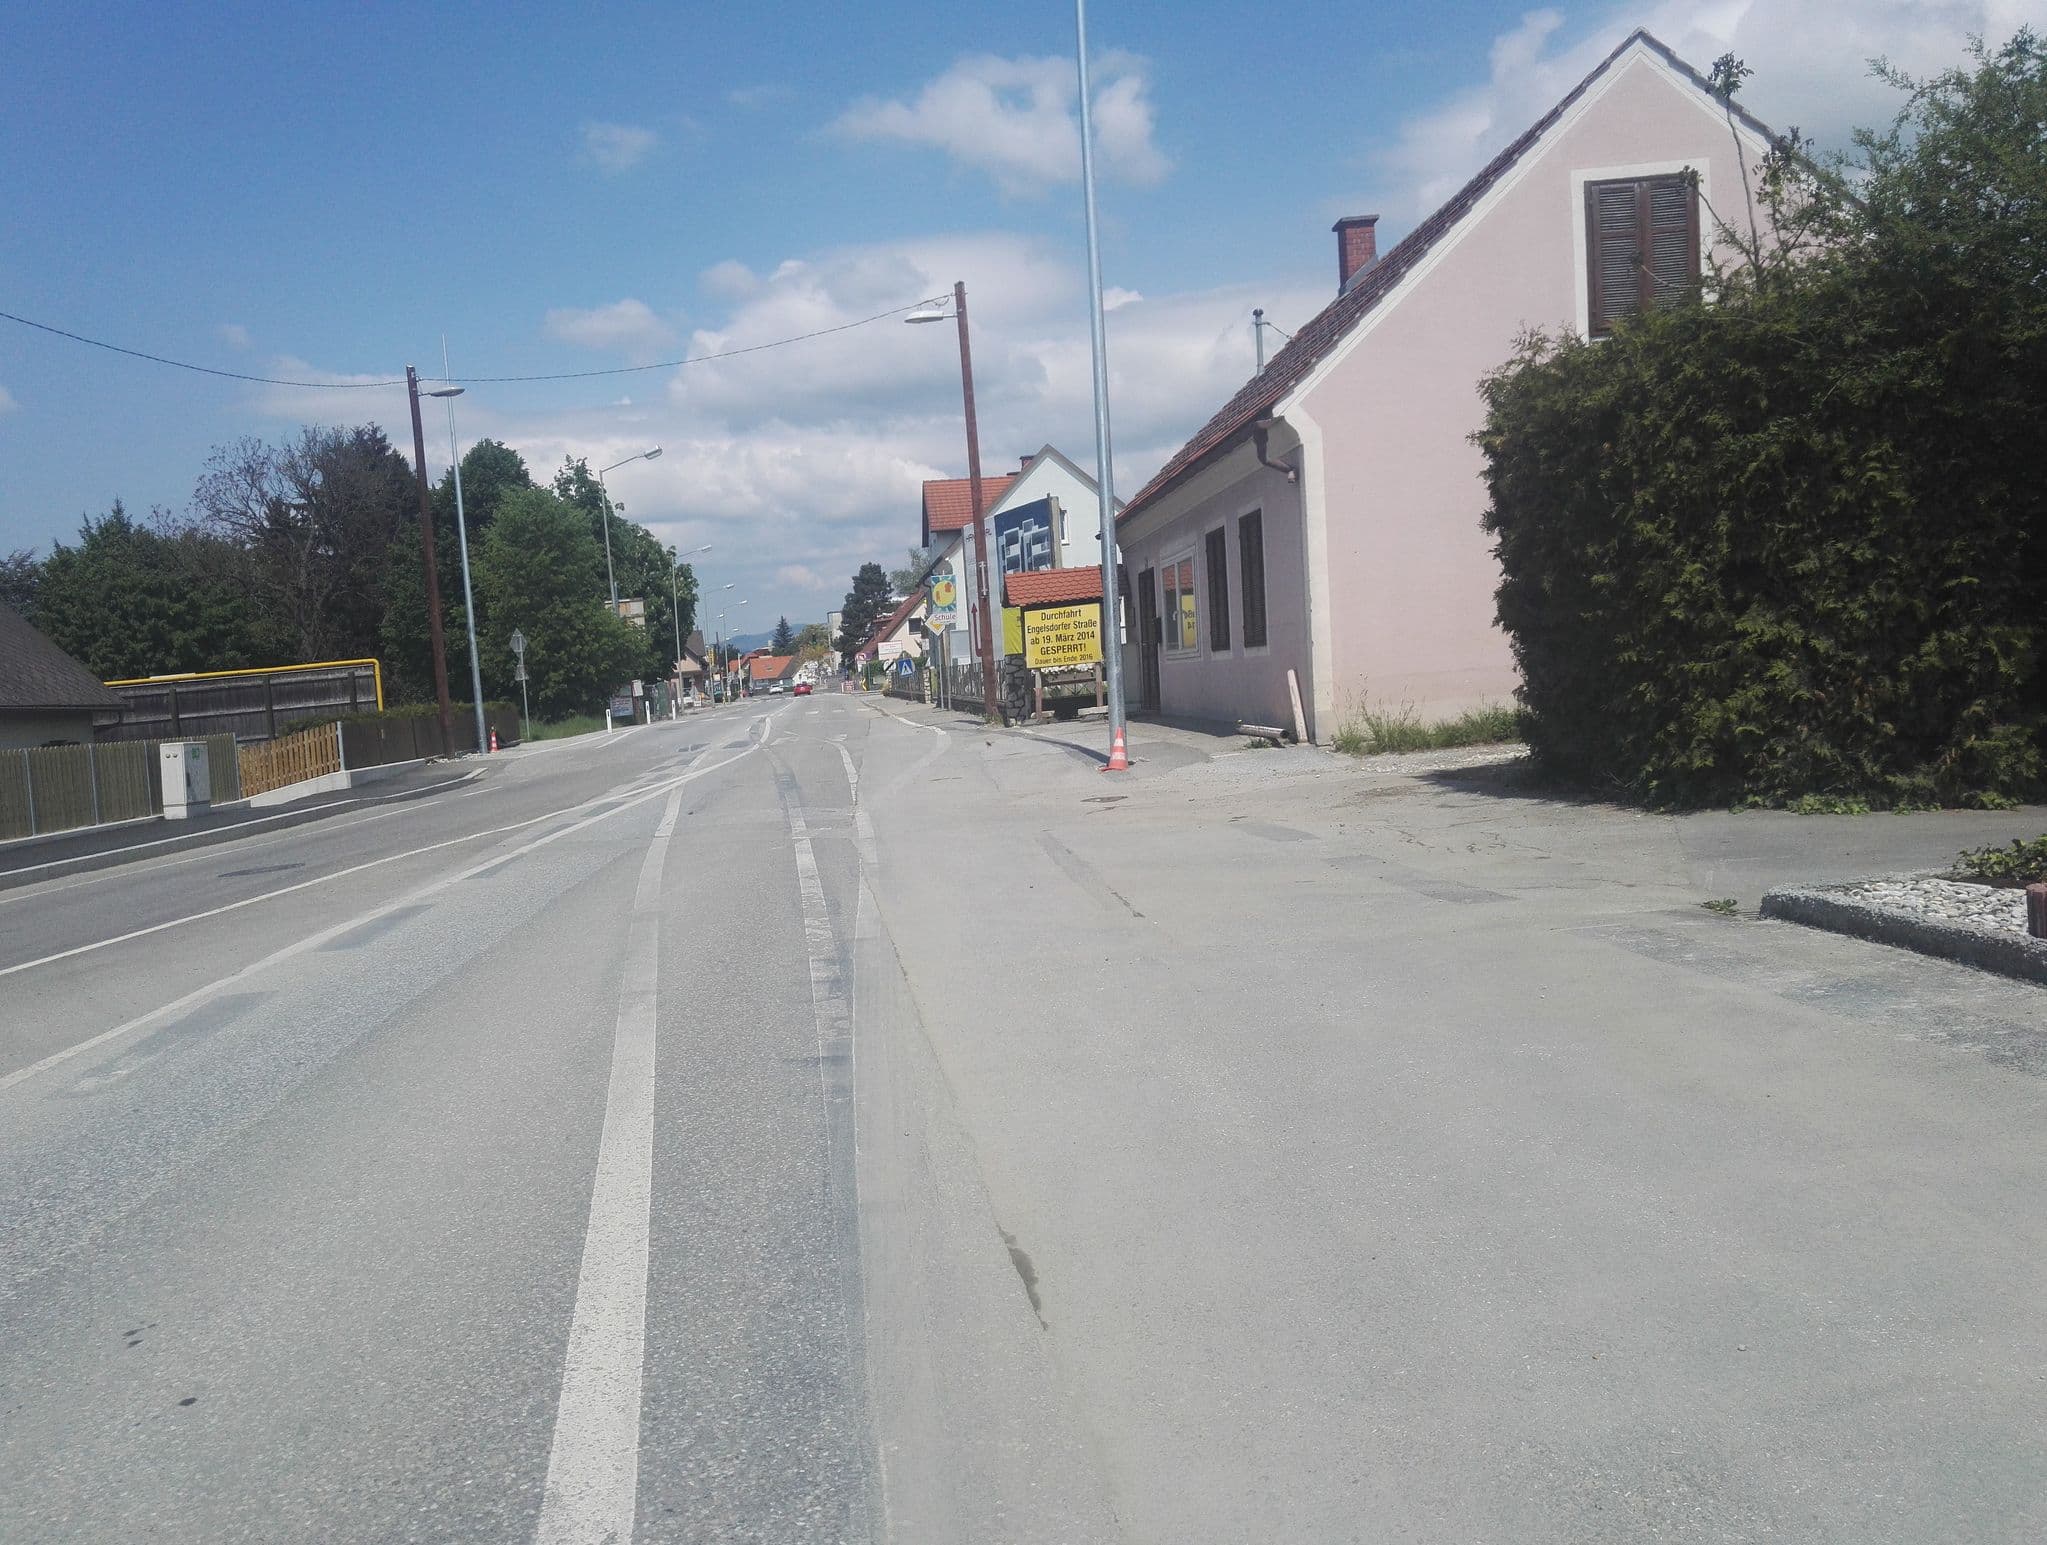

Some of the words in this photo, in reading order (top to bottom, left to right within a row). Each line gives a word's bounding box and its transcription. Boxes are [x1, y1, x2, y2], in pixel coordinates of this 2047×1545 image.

[934, 613, 957, 621] Schule
[1041, 609, 1081, 621] Durchfahrt
[1027, 622, 1071, 634] Engelsdorfer
[1073, 619, 1097, 629] Straße
[1030, 636, 1040, 645] ab
[1042, 635, 1053, 644] 19.
[1076, 630, 1095, 641] 2014
[1040, 643, 1087, 656] GESPERRT!
